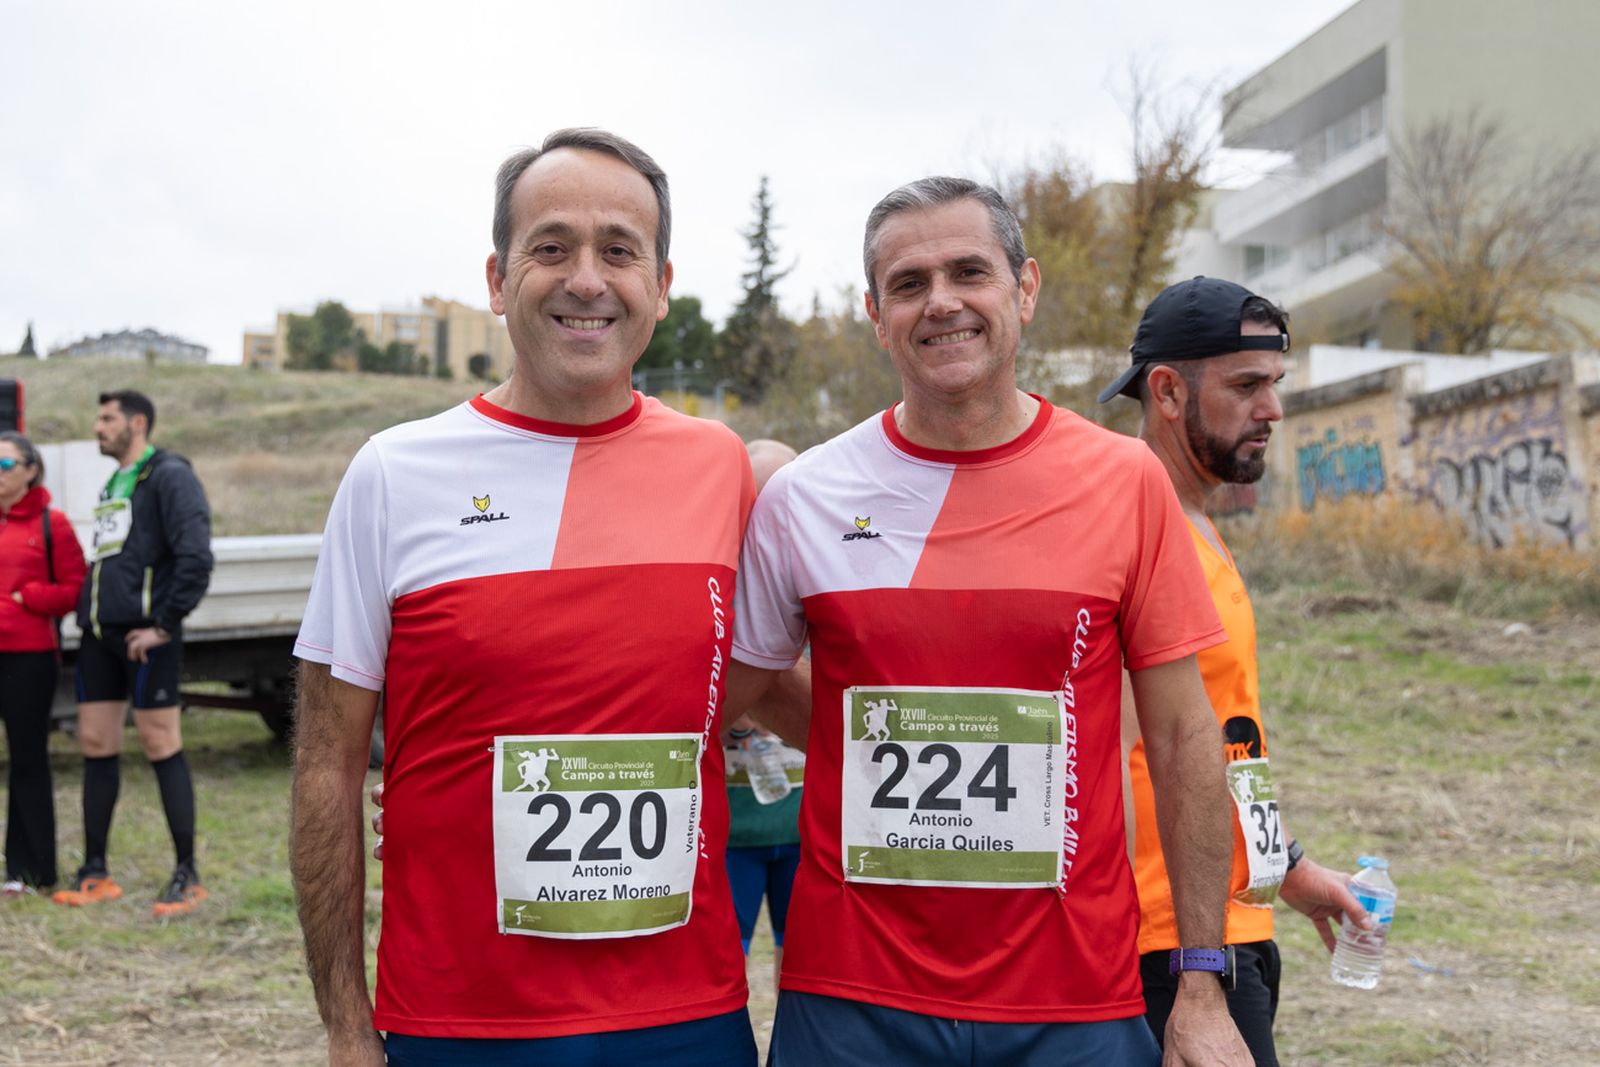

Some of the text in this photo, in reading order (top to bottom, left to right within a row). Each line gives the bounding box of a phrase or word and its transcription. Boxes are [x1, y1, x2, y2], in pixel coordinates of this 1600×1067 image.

[460, 512, 510, 526] SPALL
[841, 531, 883, 541] SPALL
[708, 576, 725, 640] CLUB
[1072, 608, 1091, 669] CLUB
[900, 708, 926, 721] XXVIII
[927, 714, 954, 722] Circuito
[955, 714, 988, 722] Provincial
[900, 721, 999, 733] Campo a través
[1045, 721, 1053, 760] Masculino
[561, 757, 654, 770] XXVIII Circuito Provincial de
[1045, 762, 1053, 784] Largo
[561, 769, 655, 782] Campo a través
[870, 742, 1017, 812] 224
[1044, 786, 1052, 808] Cross
[526, 791, 668, 861] 220
[686, 794, 698, 854] Veterano
[909, 812, 973, 827] Antonio
[1250, 802, 1285, 856] 32
[886, 832, 1014, 852] Garcia Quiles
[572, 863, 632, 878] Antonio
[536, 883, 671, 902] Alvarez Moreno
